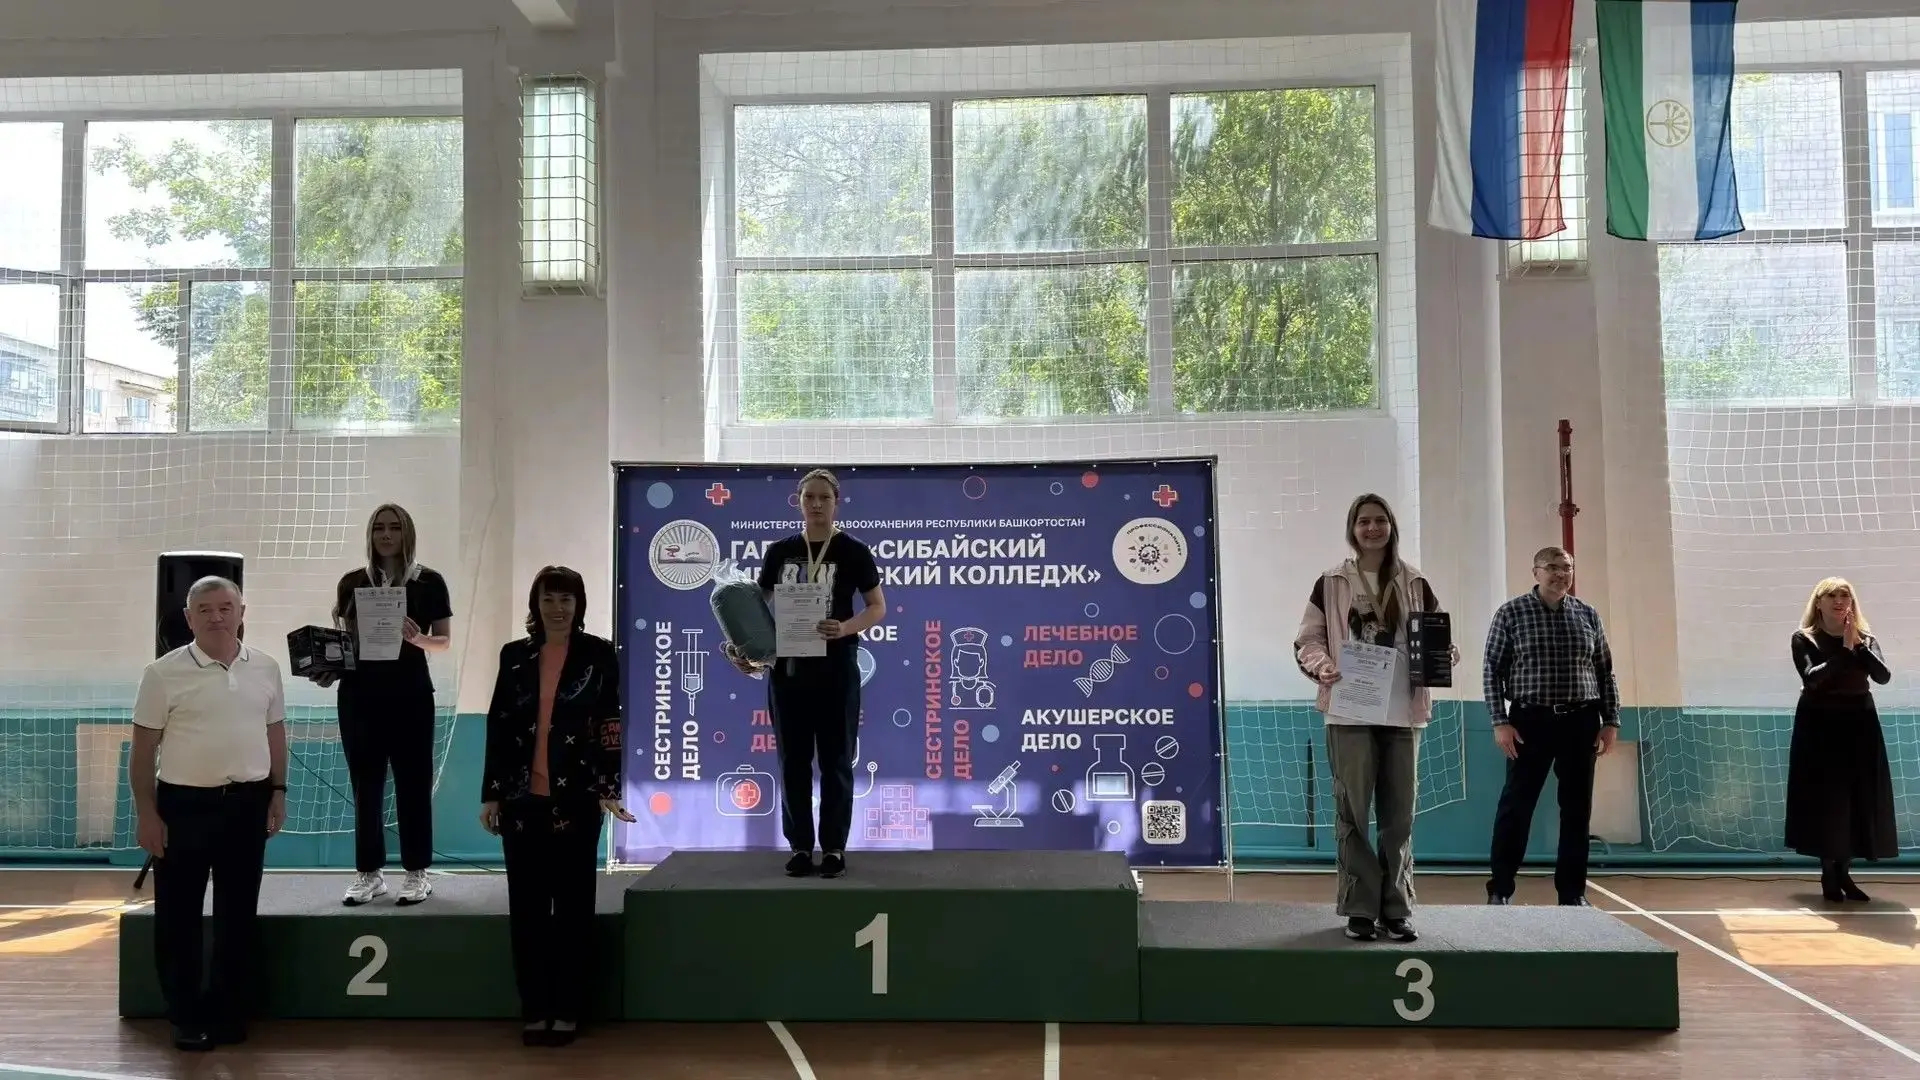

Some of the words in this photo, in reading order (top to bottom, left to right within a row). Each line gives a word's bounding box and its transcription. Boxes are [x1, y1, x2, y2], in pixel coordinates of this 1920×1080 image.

[731, 520, 807, 530] МИНИСТЕРСТВ
[833, 519, 923, 529] РАВООХРАНЕНИЯ
[925, 518, 997, 529] РЕСПУБЛИКИ
[999, 518, 1086, 528] БАШКОРТОСТАН
[949, 564, 1101, 588] КОЛЛЕДЖ»
[1023, 624, 1138, 642] ЛЕЧЕБНОЕ
[1023, 649, 1083, 668] ДЕЛО
[654, 621, 672, 780] СЕСТРИНСКОЕ
[925, 619, 942, 780] СЕСТРИНСКОЕ
[1021, 708, 1175, 726] АКУШЕРСКОЕ
[682, 720, 701, 781] ДЕЛО
[953, 719, 972, 780] ДЕЛО
[1021, 733, 1082, 752] ДЕЛО
[346, 934, 389, 996] 2
[855, 912, 889, 995] 1
[1392, 958, 1435, 1022] 3
